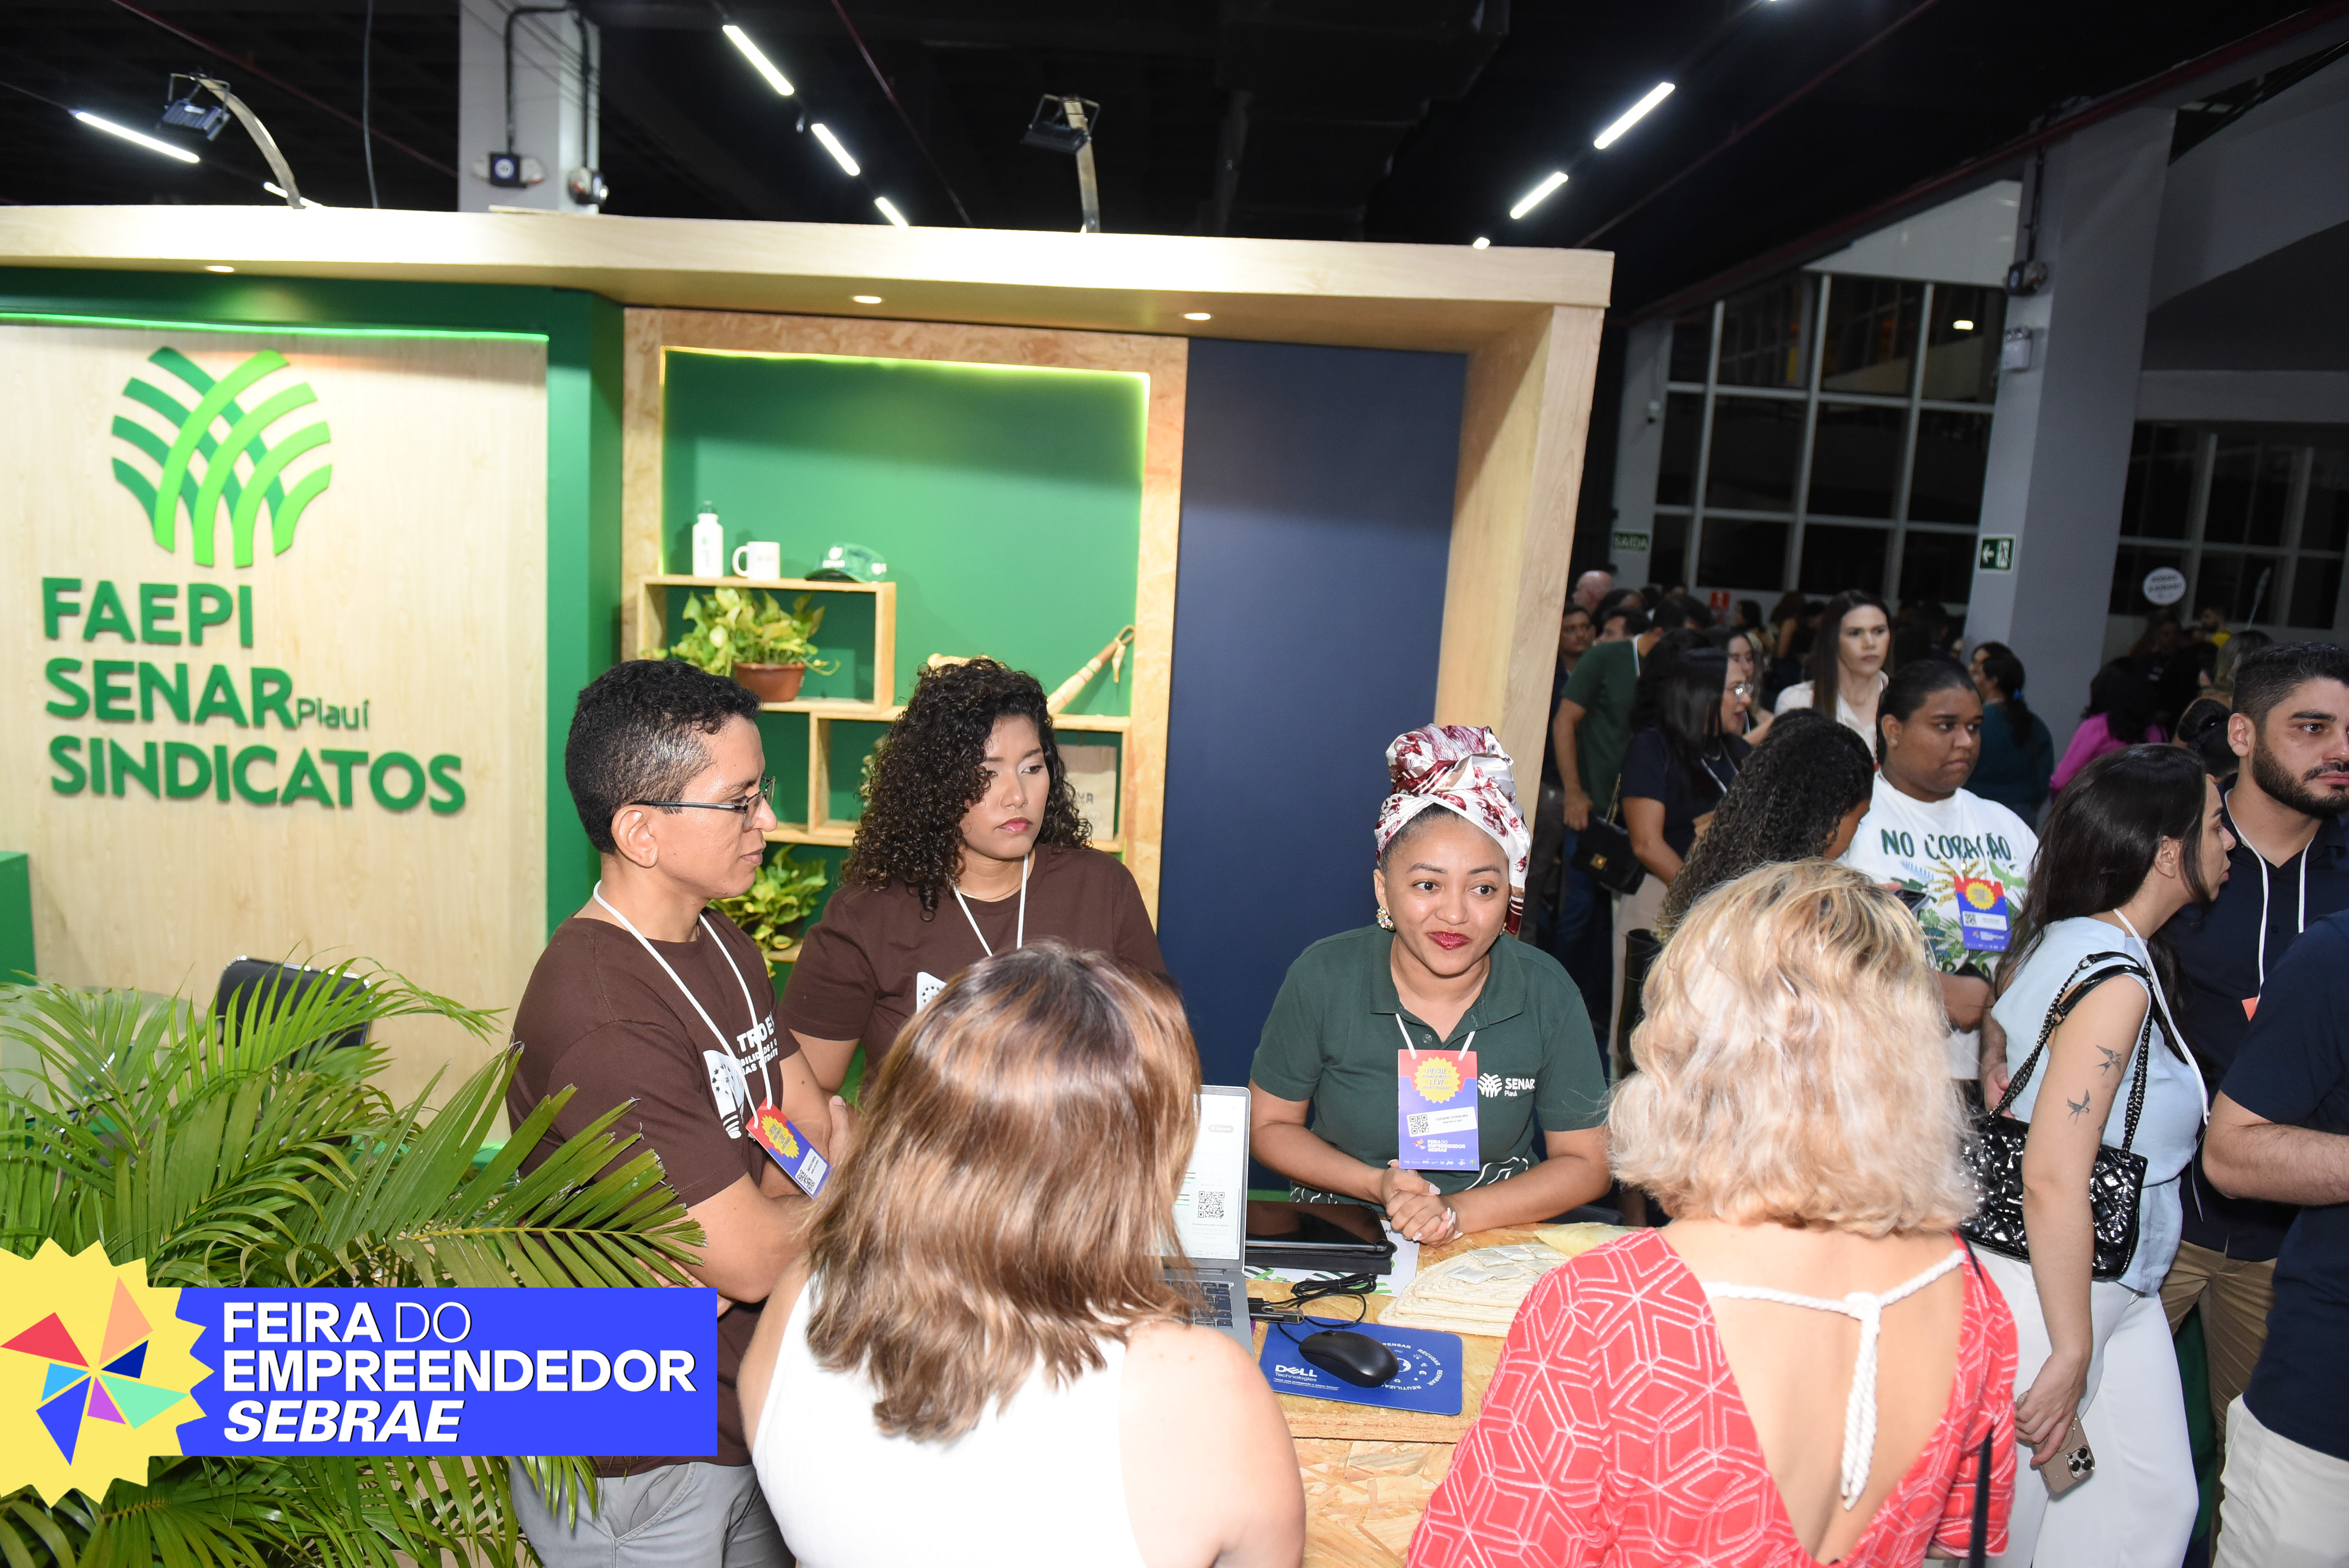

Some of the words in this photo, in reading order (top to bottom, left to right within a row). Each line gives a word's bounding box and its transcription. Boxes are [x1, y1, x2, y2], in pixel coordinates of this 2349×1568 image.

[42, 577, 253, 647] FAEPI
[45, 657, 296, 729] SENAR
[298, 698, 369, 729] Piauí
[50, 735, 466, 814] SINDICATOS
[1881, 828, 1915, 858] NO
[1505, 1078, 1535, 1090] SENAR
[1416, 1349, 1441, 1366] RECUSAR
[1275, 1365, 1317, 1377] DELL
[1275, 1372, 1317, 1382] Technologies
[1427, 1370, 1443, 1386] REPARAR
